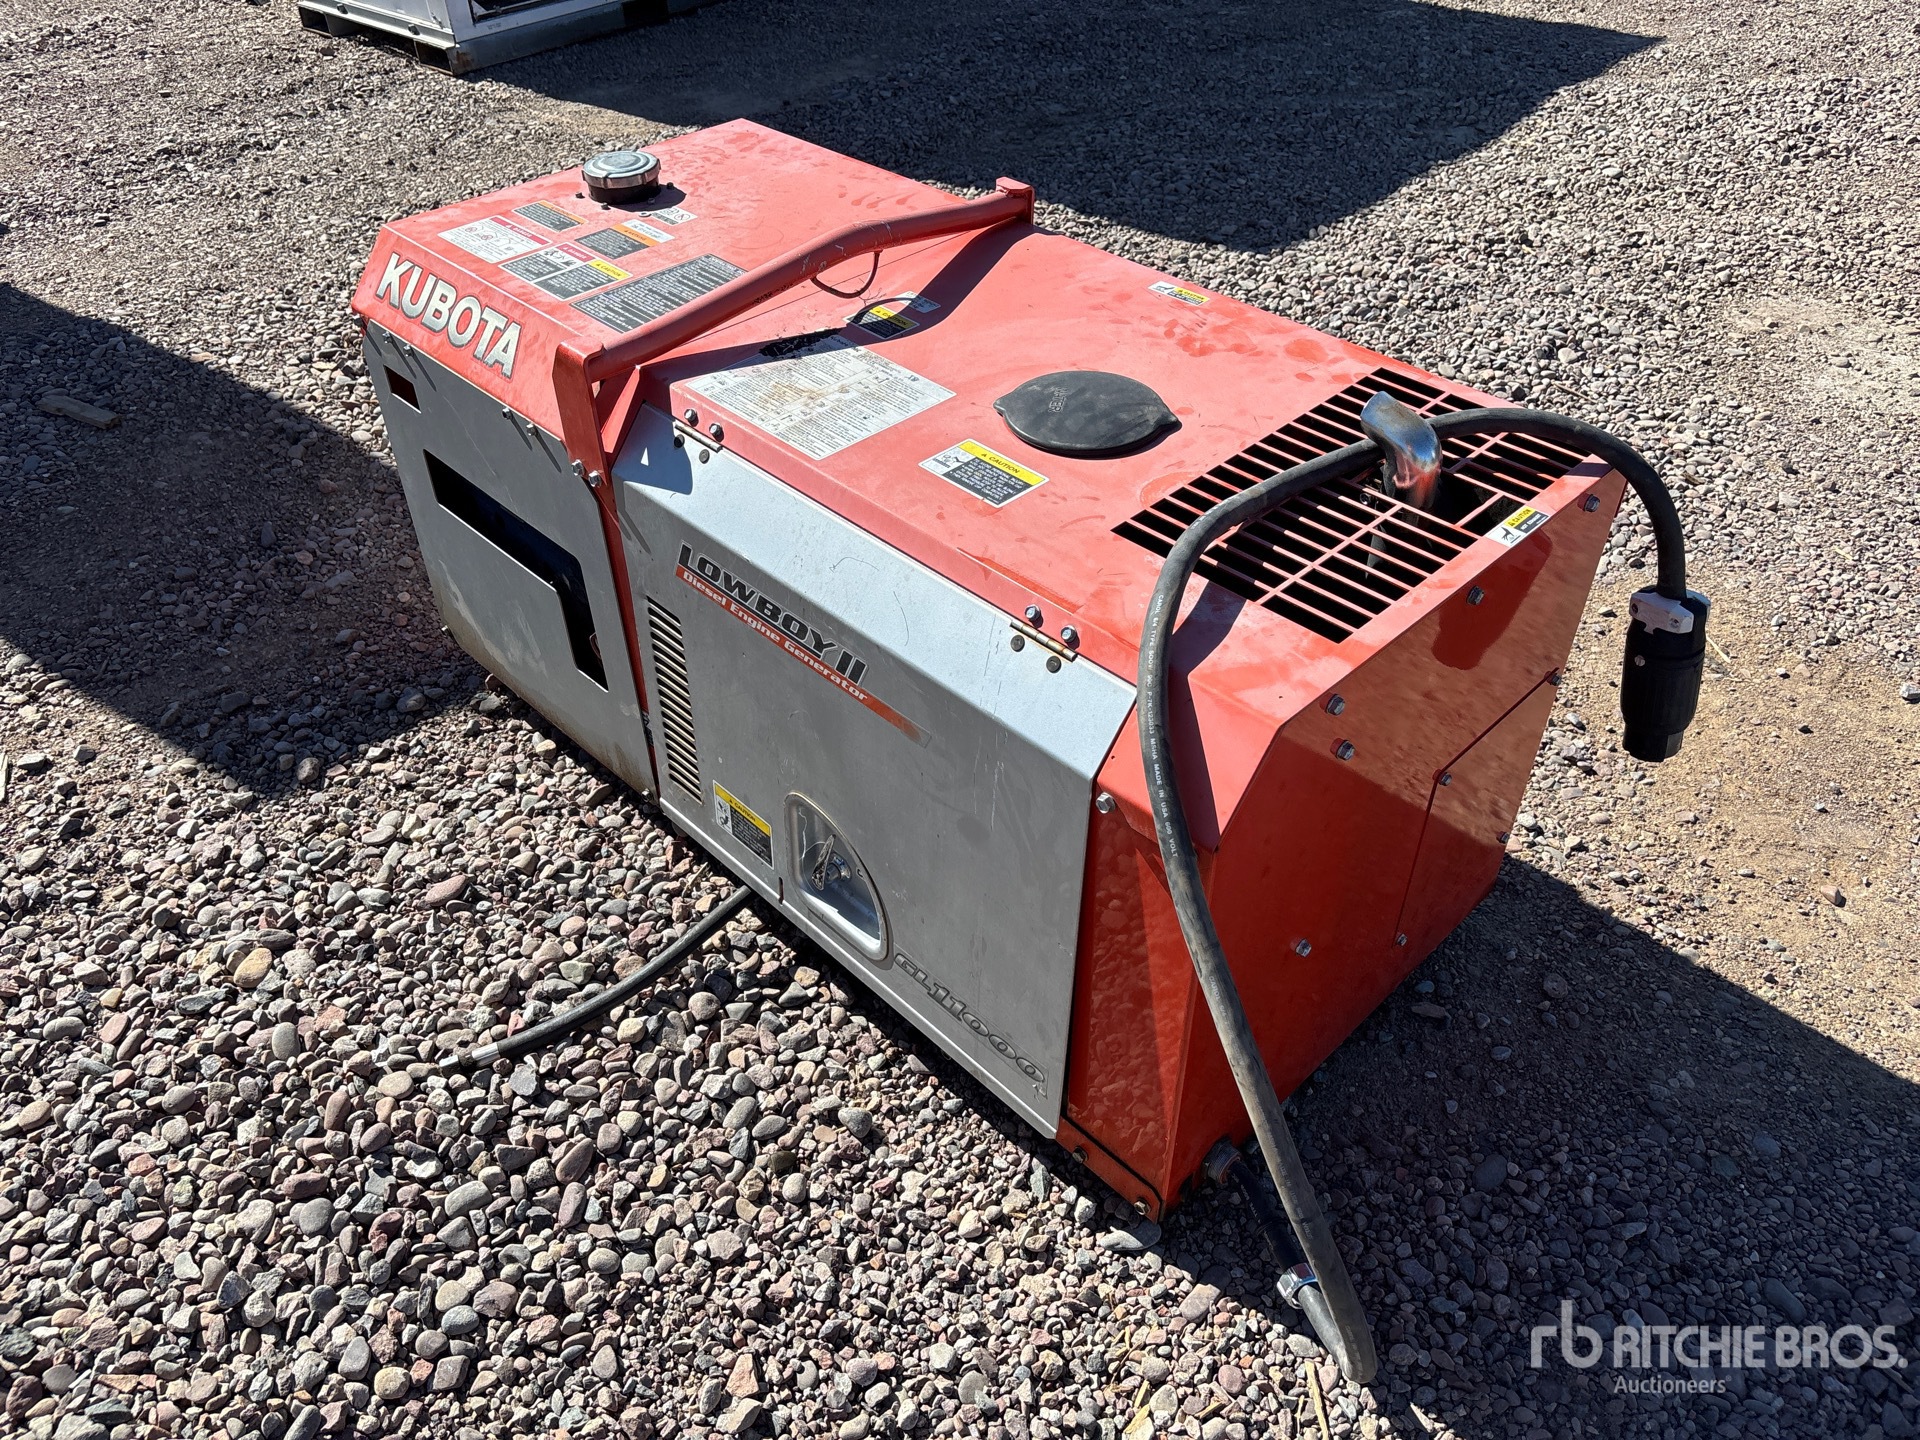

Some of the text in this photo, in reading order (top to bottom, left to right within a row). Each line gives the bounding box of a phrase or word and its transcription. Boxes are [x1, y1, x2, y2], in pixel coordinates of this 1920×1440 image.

[375, 251, 522, 380] KUBOTA
[988, 456, 1020, 474] CAUTION
[678, 541, 867, 686] LOWBOY II
[683, 570, 868, 700] Diesel Engine Generator
[1149, 630, 1157, 647] TYPE
[1150, 738, 1158, 760] MSHA
[1154, 763, 1163, 786] MADE
[1158, 789, 1165, 798] IN
[734, 801, 756, 822] CAUTION
[1160, 801, 1168, 818] USA
[1164, 821, 1173, 835] 600
[1168, 838, 1179, 858] VOLT
[894, 953, 1046, 1083] GL11000
